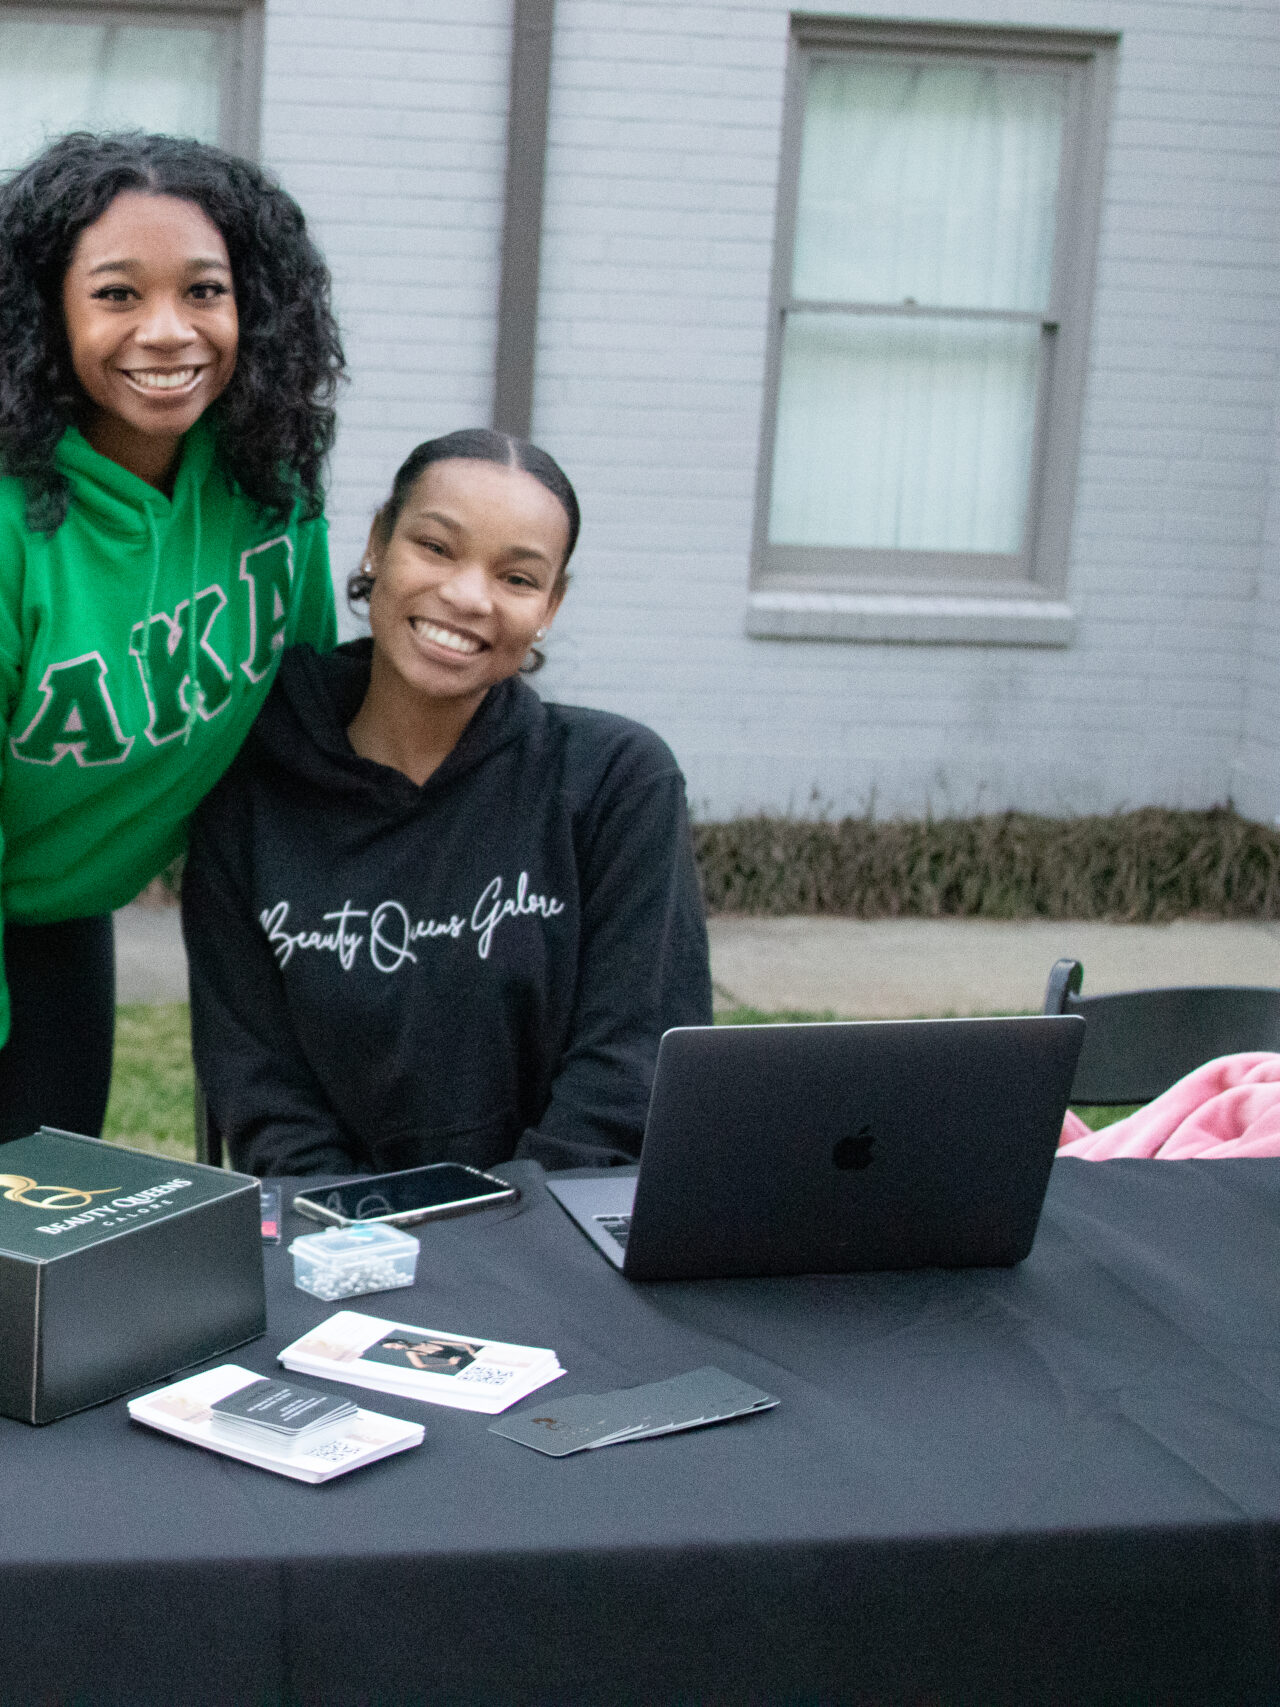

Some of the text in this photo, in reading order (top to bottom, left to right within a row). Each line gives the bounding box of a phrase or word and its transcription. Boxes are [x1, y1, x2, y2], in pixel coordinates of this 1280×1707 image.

[10, 535, 293, 767] AKA
[259, 871, 564, 973] Beauty Queens Galore
[35, 1177, 193, 1235] BEAUTY QUEENS
[102, 1199, 174, 1227] GALORE
